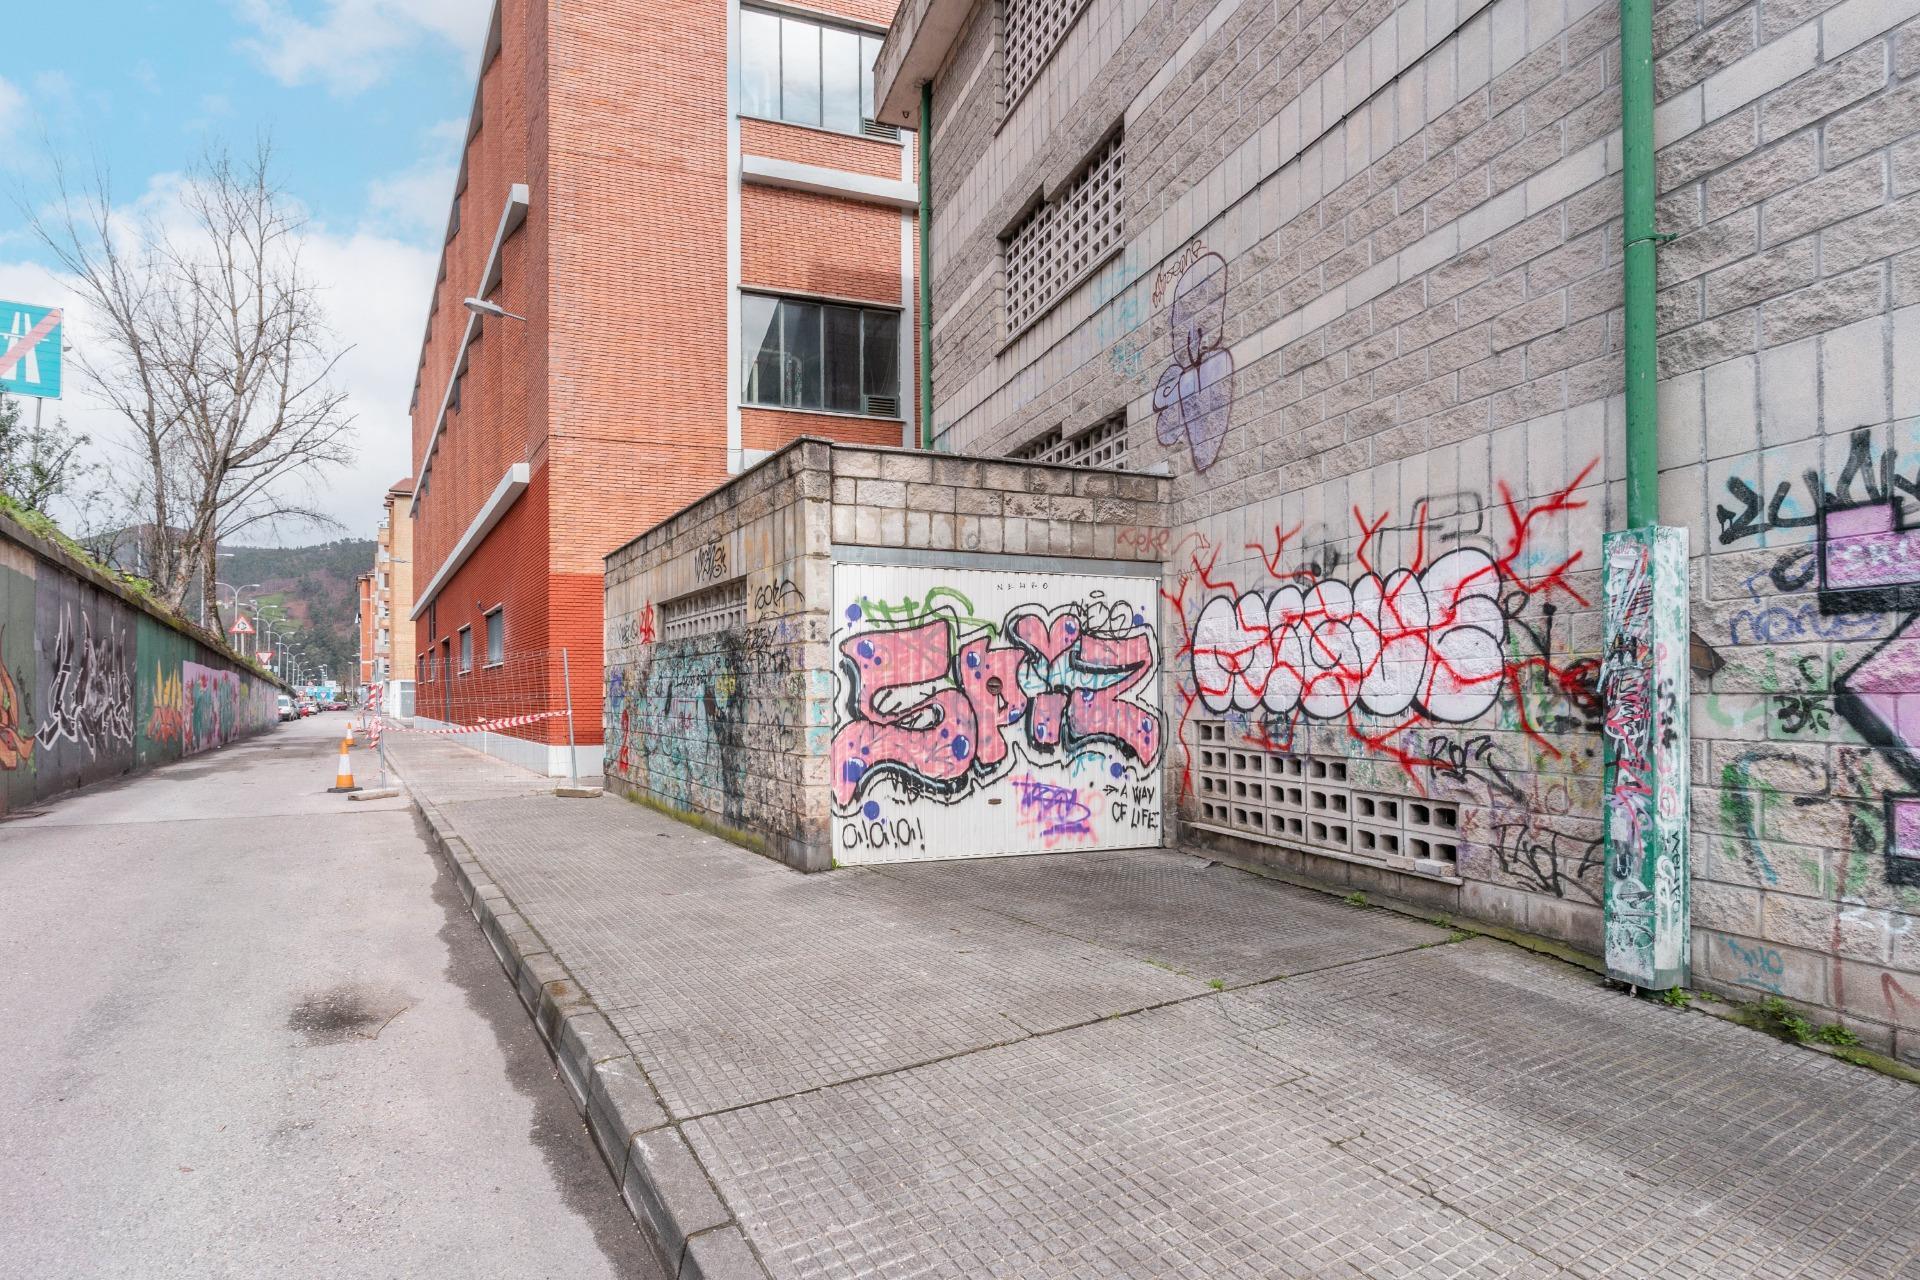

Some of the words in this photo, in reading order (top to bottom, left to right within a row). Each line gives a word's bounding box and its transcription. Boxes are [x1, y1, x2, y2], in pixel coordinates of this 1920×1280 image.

[1120, 782, 1128, 799] A
[1132, 785, 1155, 806] WAY
[1131, 808, 1160, 829] LIFE
